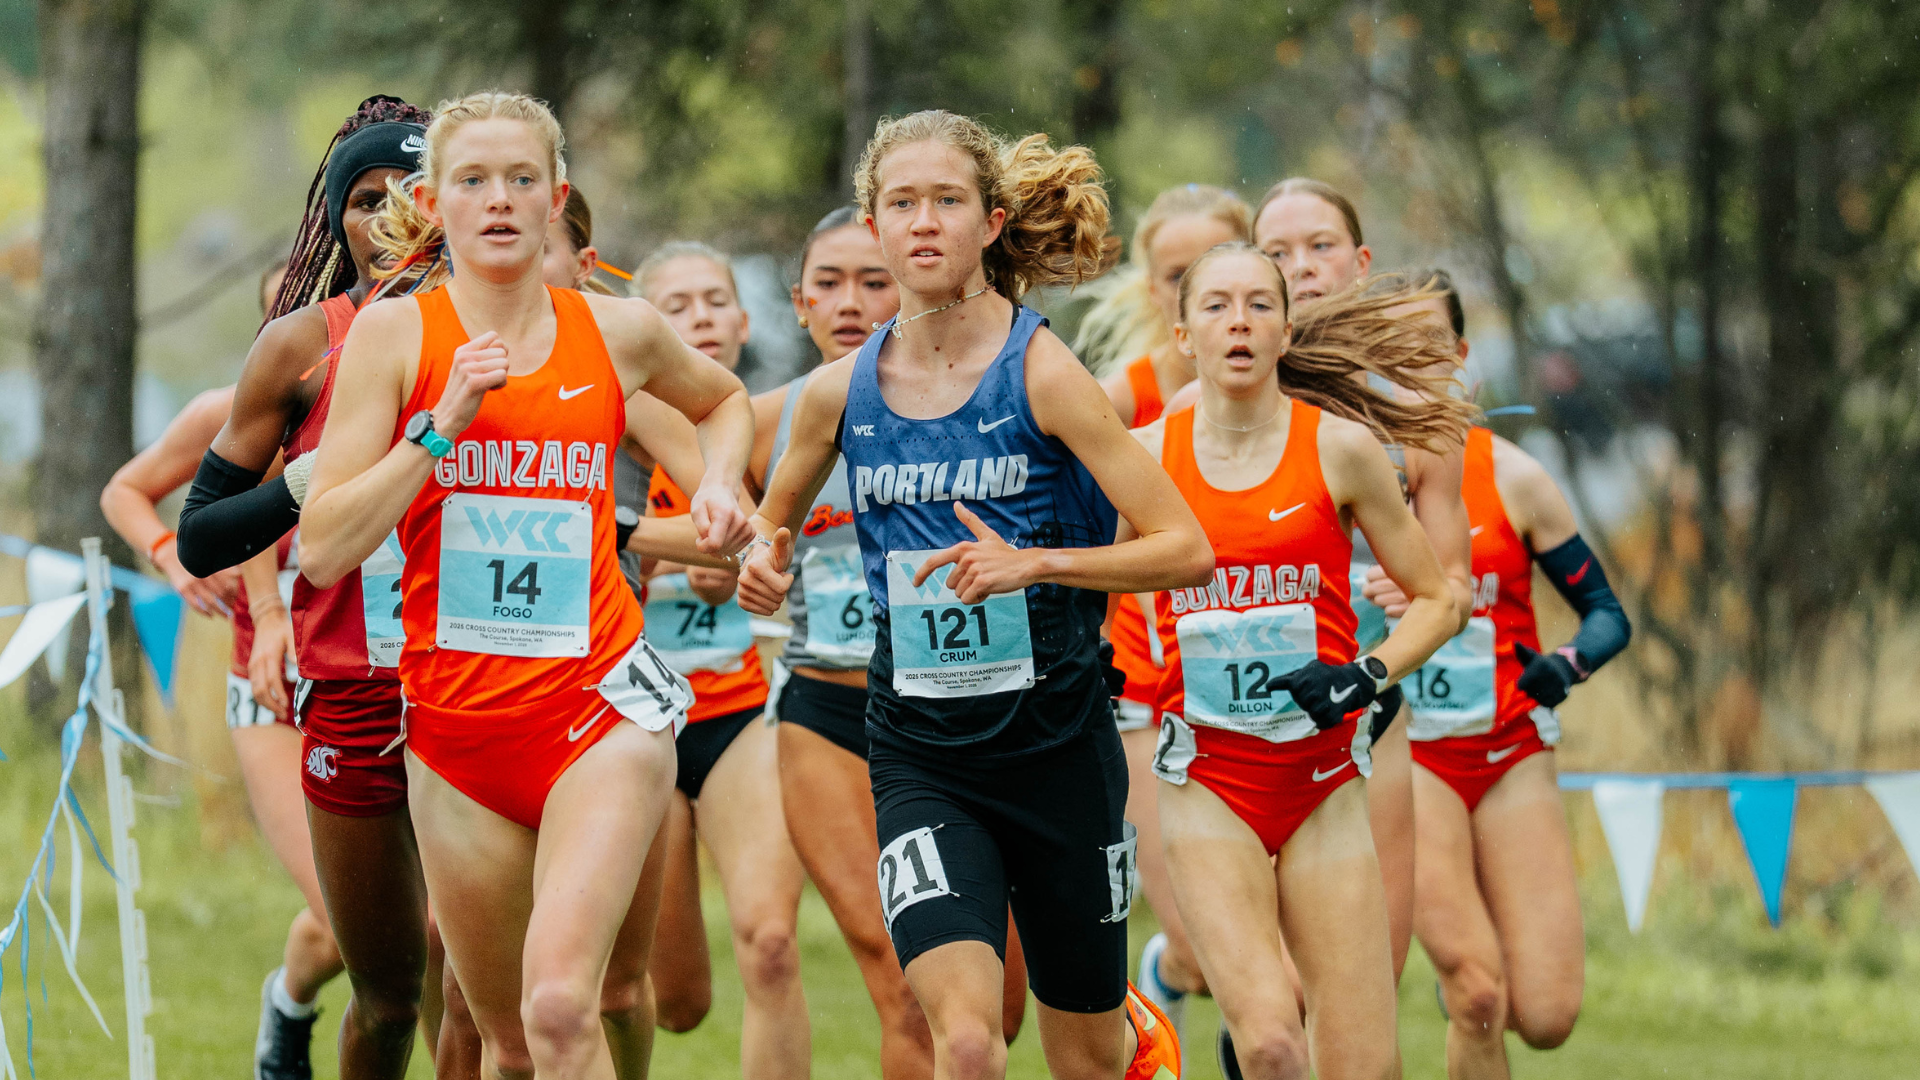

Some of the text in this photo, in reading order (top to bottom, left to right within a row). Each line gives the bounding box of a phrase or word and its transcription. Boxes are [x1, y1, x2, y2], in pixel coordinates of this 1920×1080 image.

[852, 424, 875, 437] WCC
[434, 440, 607, 491] GONZAGA
[856, 453, 1029, 514] PORTLAND
[463, 505, 573, 553] WCC
[486, 559, 542, 605] 14
[493, 606, 533, 619] FOGO
[675, 603, 717, 637] 74
[920, 605, 990, 651] 121
[449, 622, 576, 638] 2025 CROSS COUNTRY CHAMPIONSHIPS
[509, 635, 533, 643] Spokane,
[1196, 614, 1297, 654] WCC
[938, 671, 968, 679] COUNTRY
[968, 664, 1022, 677] CHAMPIONSHIPS
[939, 650, 978, 663] CRUM
[941, 678, 959, 686] Course,
[959, 677, 982, 685] Spokane,
[1223, 661, 1272, 701] 12
[1414, 668, 1451, 699] 16
[1228, 701, 1273, 714] DILLON
[1259, 714, 1307, 727] CHAMPIONSHIPS
[880, 837, 939, 916] 21
